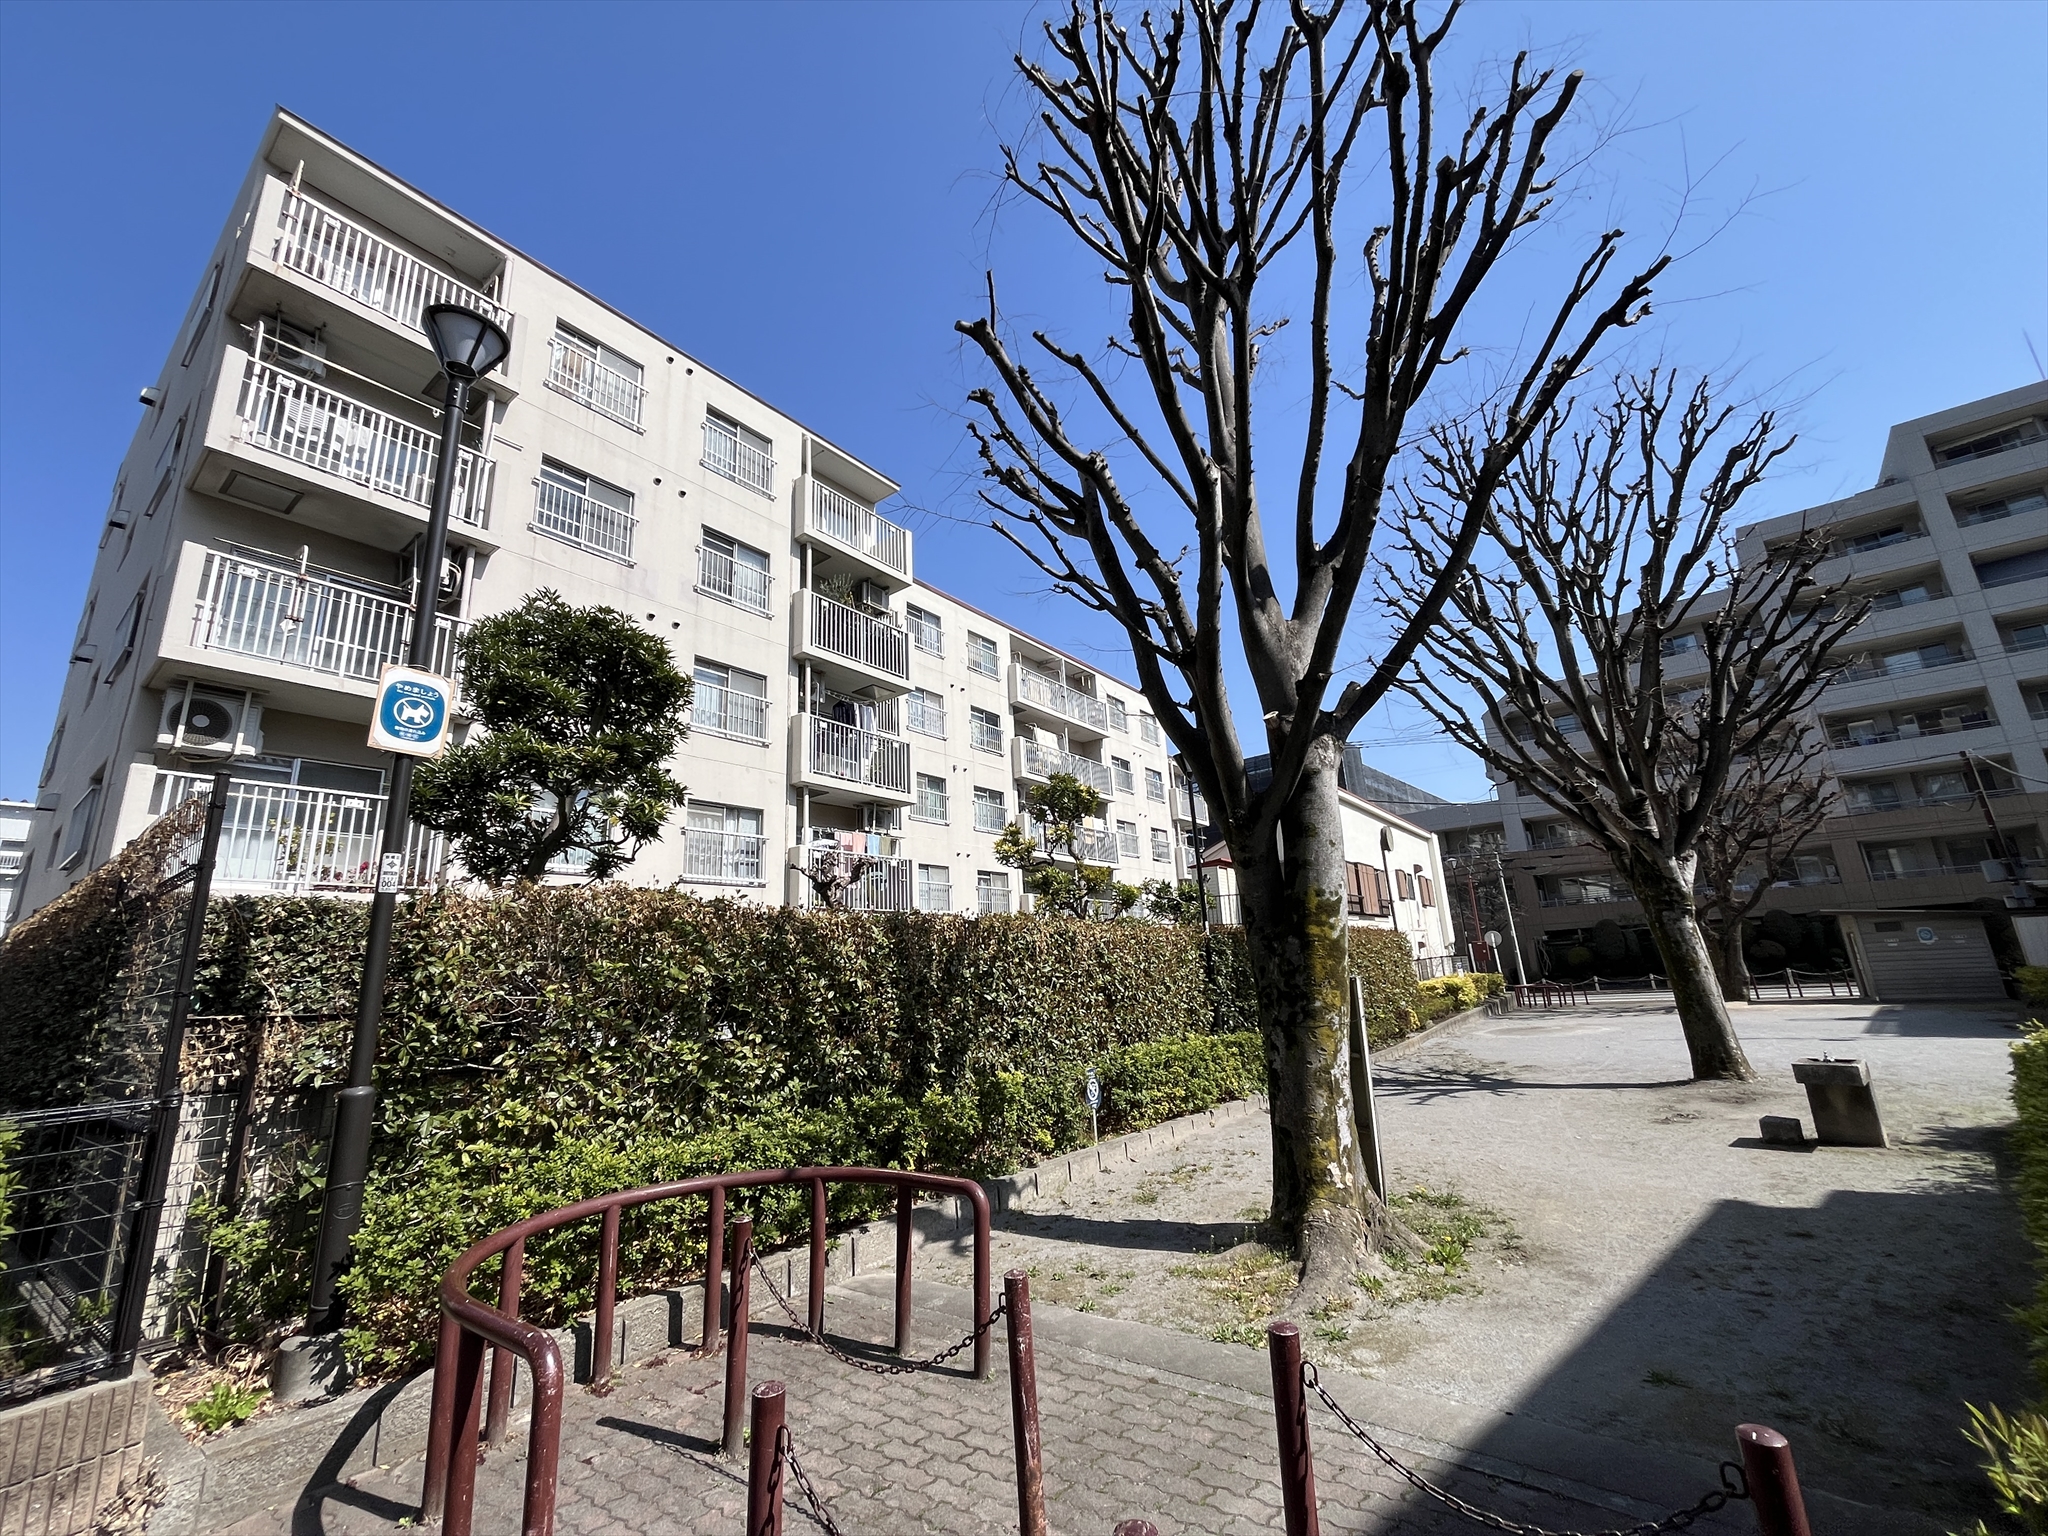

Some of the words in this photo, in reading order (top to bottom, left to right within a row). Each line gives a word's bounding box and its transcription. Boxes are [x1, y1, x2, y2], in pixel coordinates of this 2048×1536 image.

[395, 682, 439, 699] やめましょう
